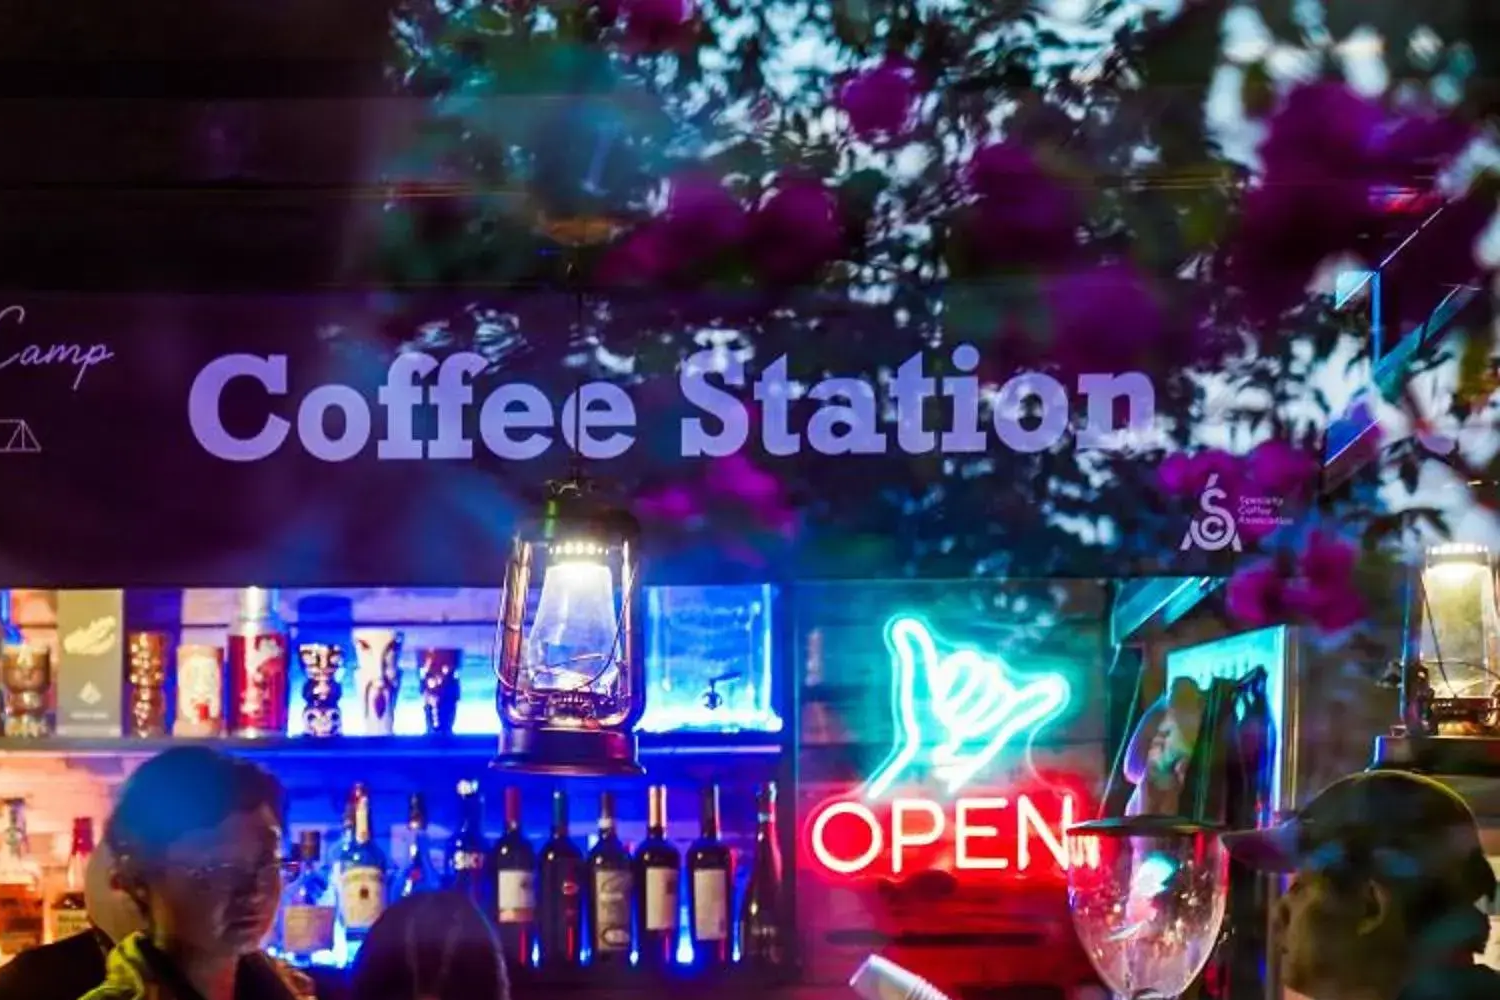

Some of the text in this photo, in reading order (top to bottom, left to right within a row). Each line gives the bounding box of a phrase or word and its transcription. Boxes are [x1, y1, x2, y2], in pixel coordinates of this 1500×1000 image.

[187, 343, 1157, 463] Coffee Station
[811, 793, 1074, 874] OPEN
